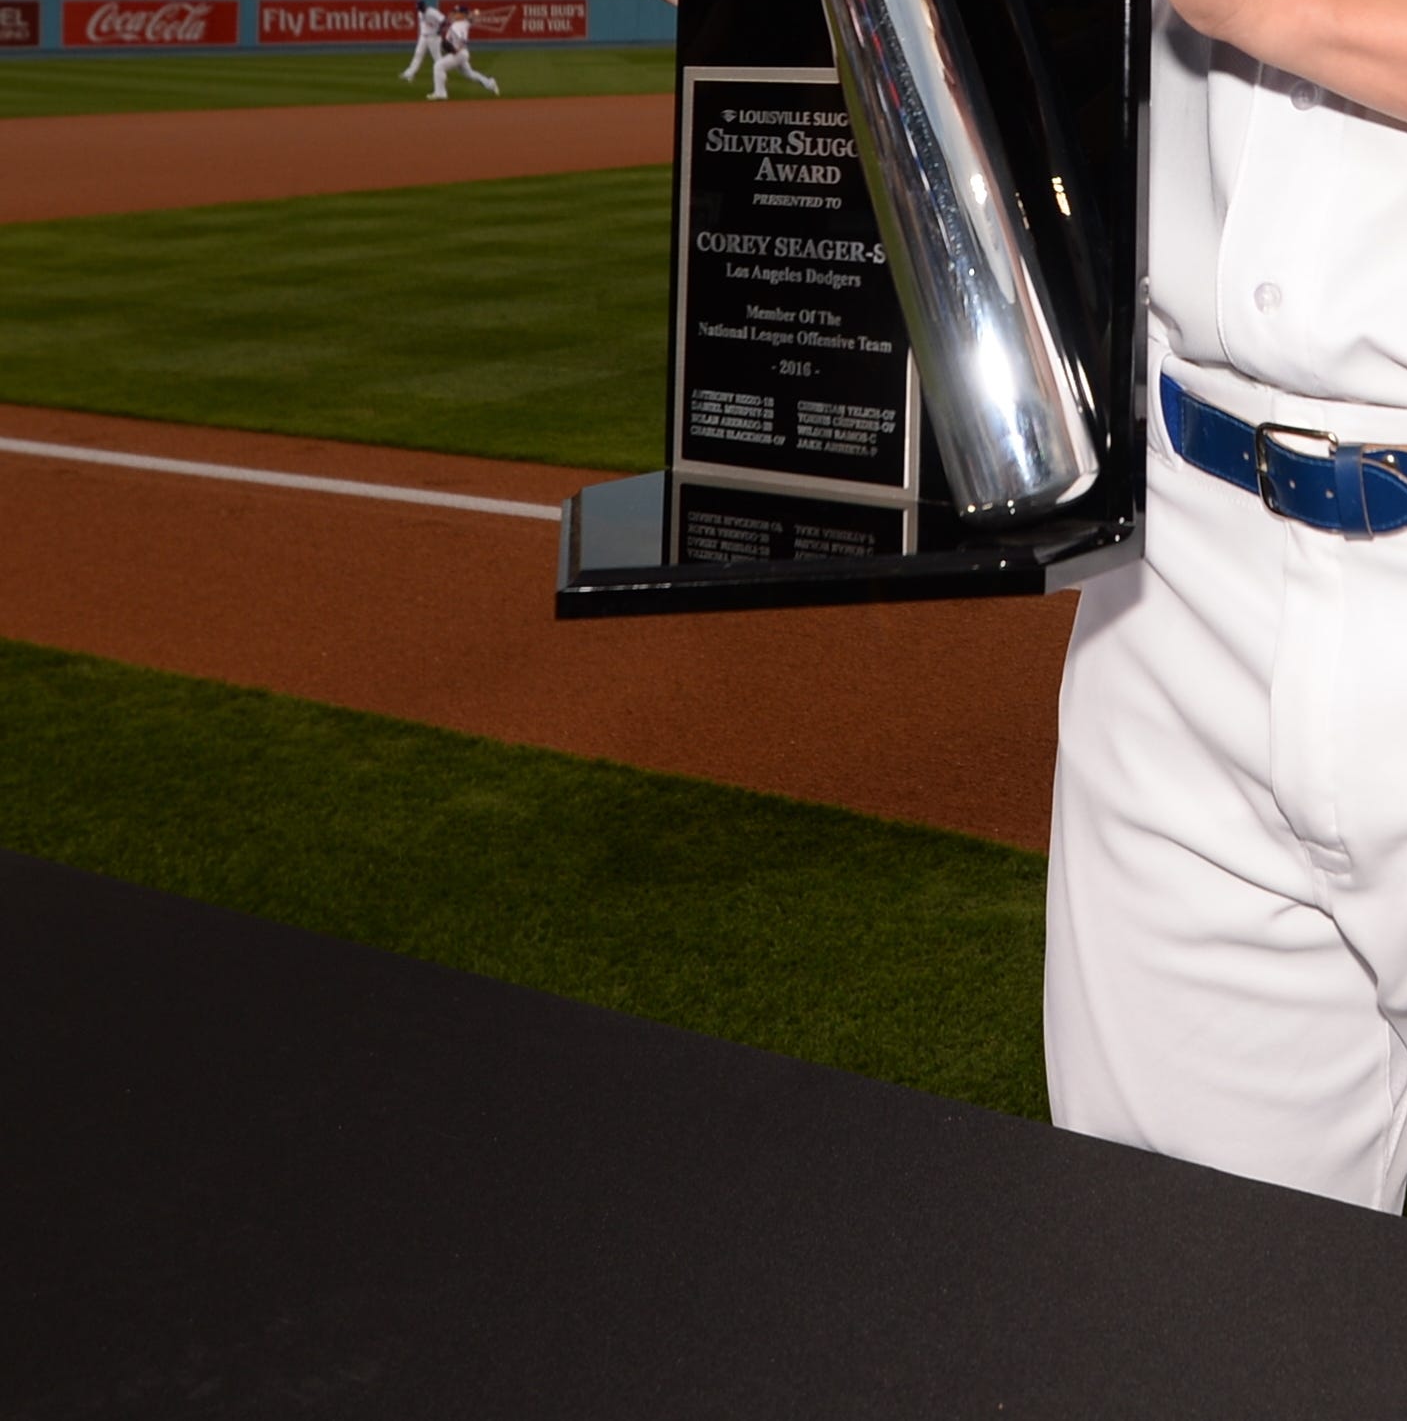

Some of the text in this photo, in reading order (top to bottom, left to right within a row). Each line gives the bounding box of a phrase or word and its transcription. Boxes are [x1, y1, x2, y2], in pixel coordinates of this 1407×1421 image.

[262, 3, 416, 37] Fly Emirates
[521, 3, 585, 18] THIS BUD'S
[521, 18, 545, 33] FOR
[739, 109, 812, 126] LOUISVILLE
[705, 127, 785, 155] SILVER
[754, 156, 842, 185] AWARD
[752, 193, 843, 210] PRESENTED TO
[696, 230, 772, 256] COREY
[726, 262, 862, 290] Los Angeles Dodgers
[746, 304, 842, 327] Member Of The
[698, 321, 893, 354] National League Offensive Team
[778, 359, 813, 377] 2016
